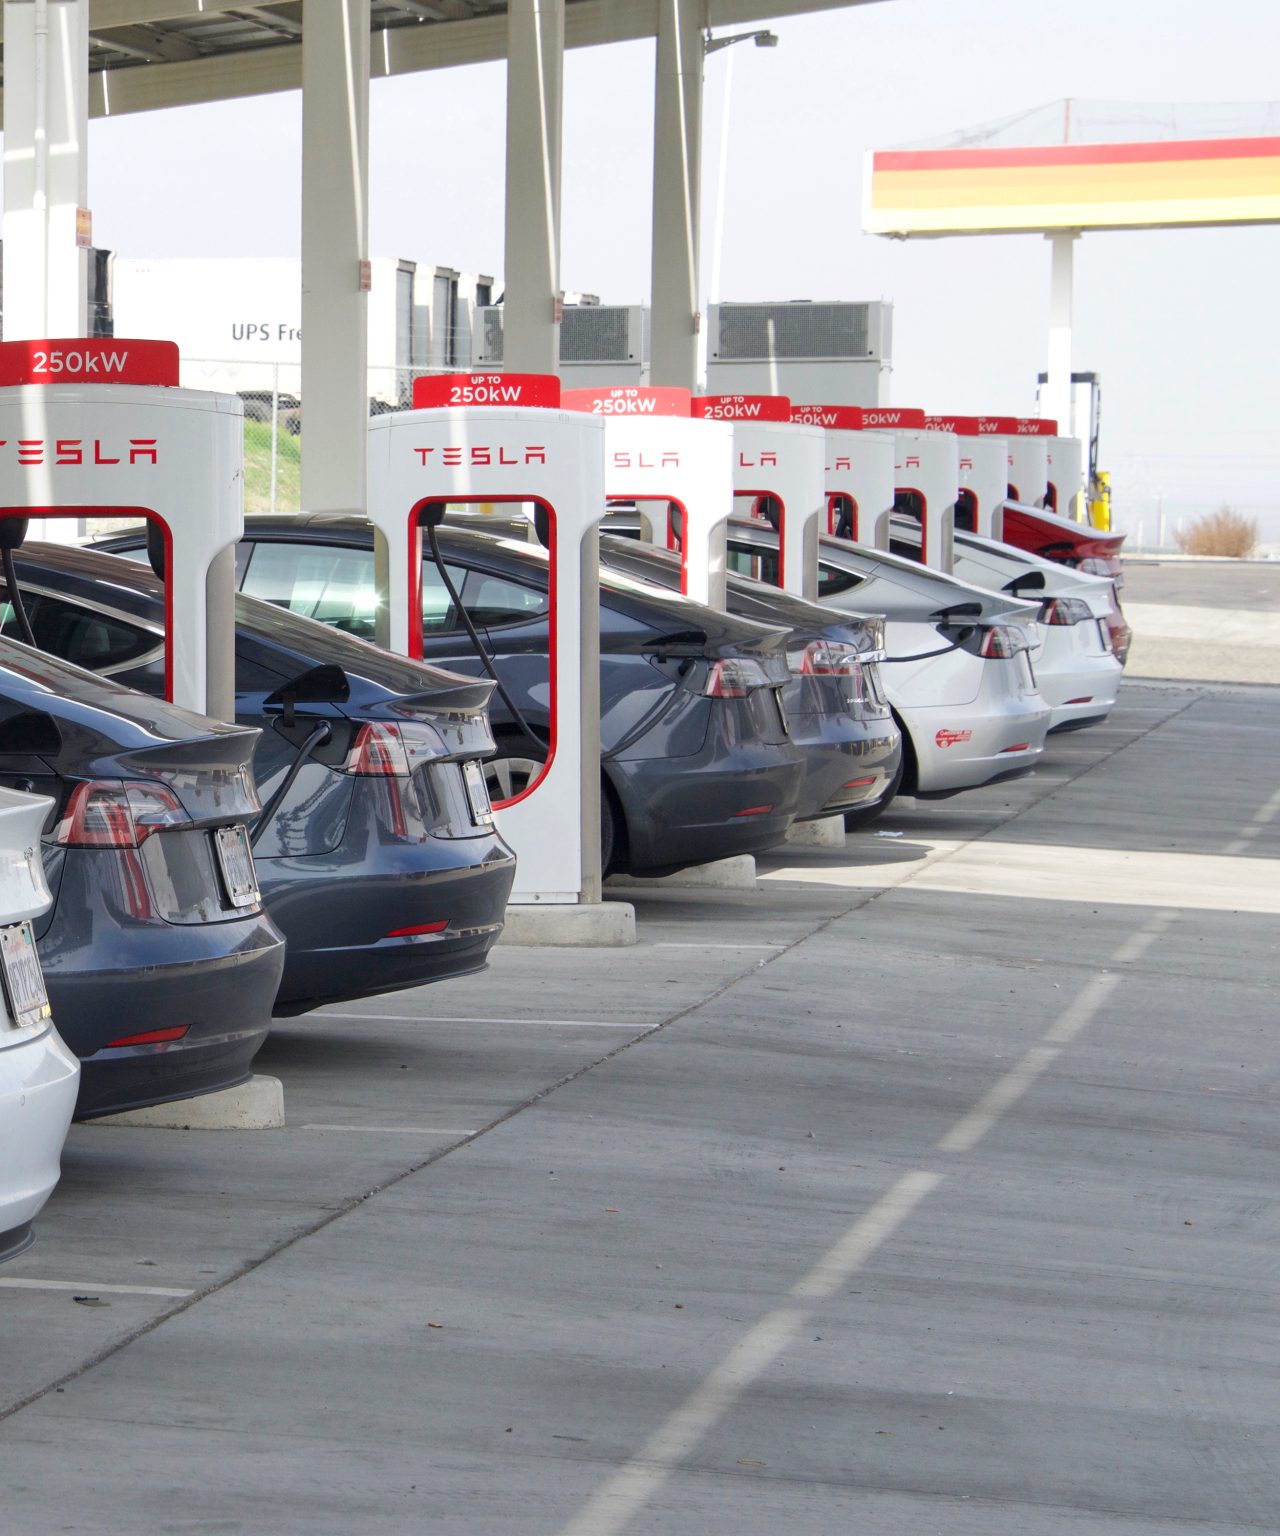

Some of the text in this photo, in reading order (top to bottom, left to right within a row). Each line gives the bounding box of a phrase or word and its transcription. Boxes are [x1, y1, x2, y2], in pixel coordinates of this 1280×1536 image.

[232, 323, 270, 341] UPS
[32, 351, 128, 373] 250kW
[471, 376, 501, 385] UP TO
[450, 386, 522, 402] 250kW
[611, 389, 638, 398] UP TO
[733, 396, 744, 404] TO
[592, 397, 656, 414] 250kW
[704, 403, 761, 419] 250kW
[789, 413, 837, 425] 50kW
[862, 413, 900, 425] 50kW
[413, 446, 546, 466] TESLA
[614, 452, 679, 468] SLA
